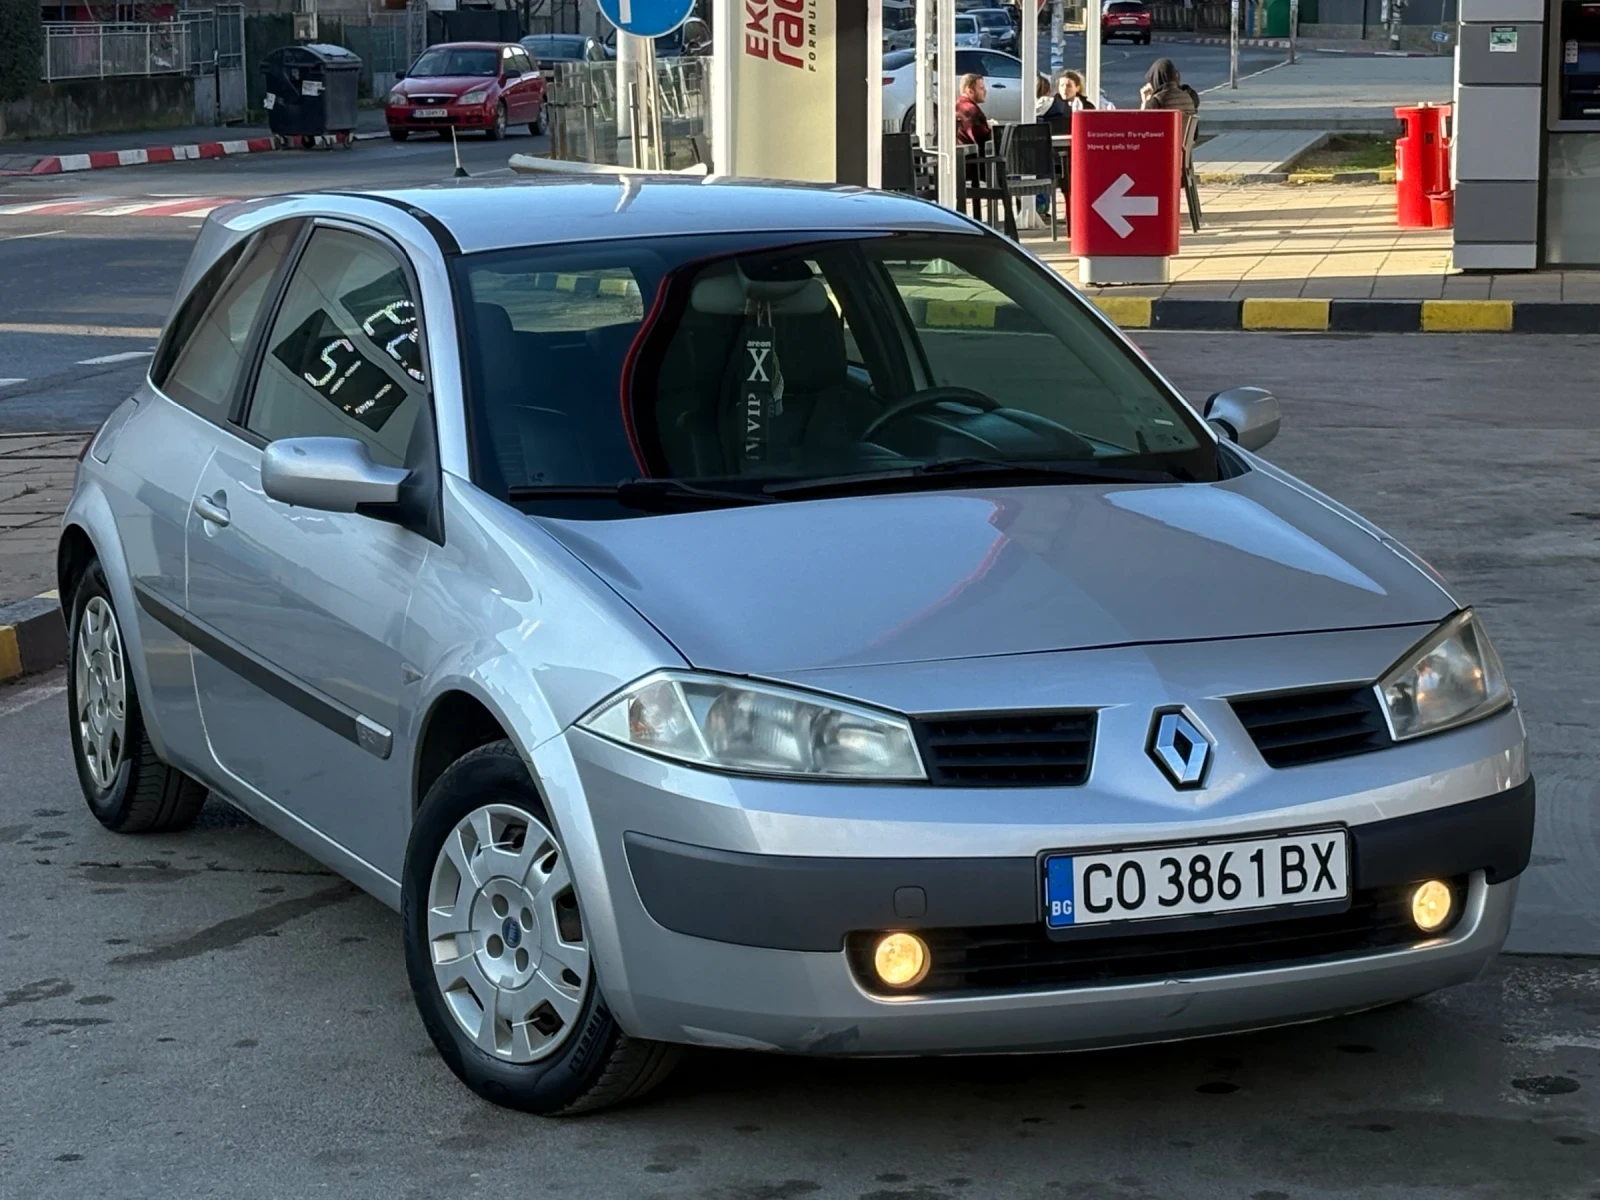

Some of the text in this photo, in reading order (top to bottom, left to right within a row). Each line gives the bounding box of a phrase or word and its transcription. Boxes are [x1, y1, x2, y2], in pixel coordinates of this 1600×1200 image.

[746, 0, 768, 60] EK
[747, 348, 771, 382] X
[1051, 840, 1337, 917] BG CO 3861 BX
